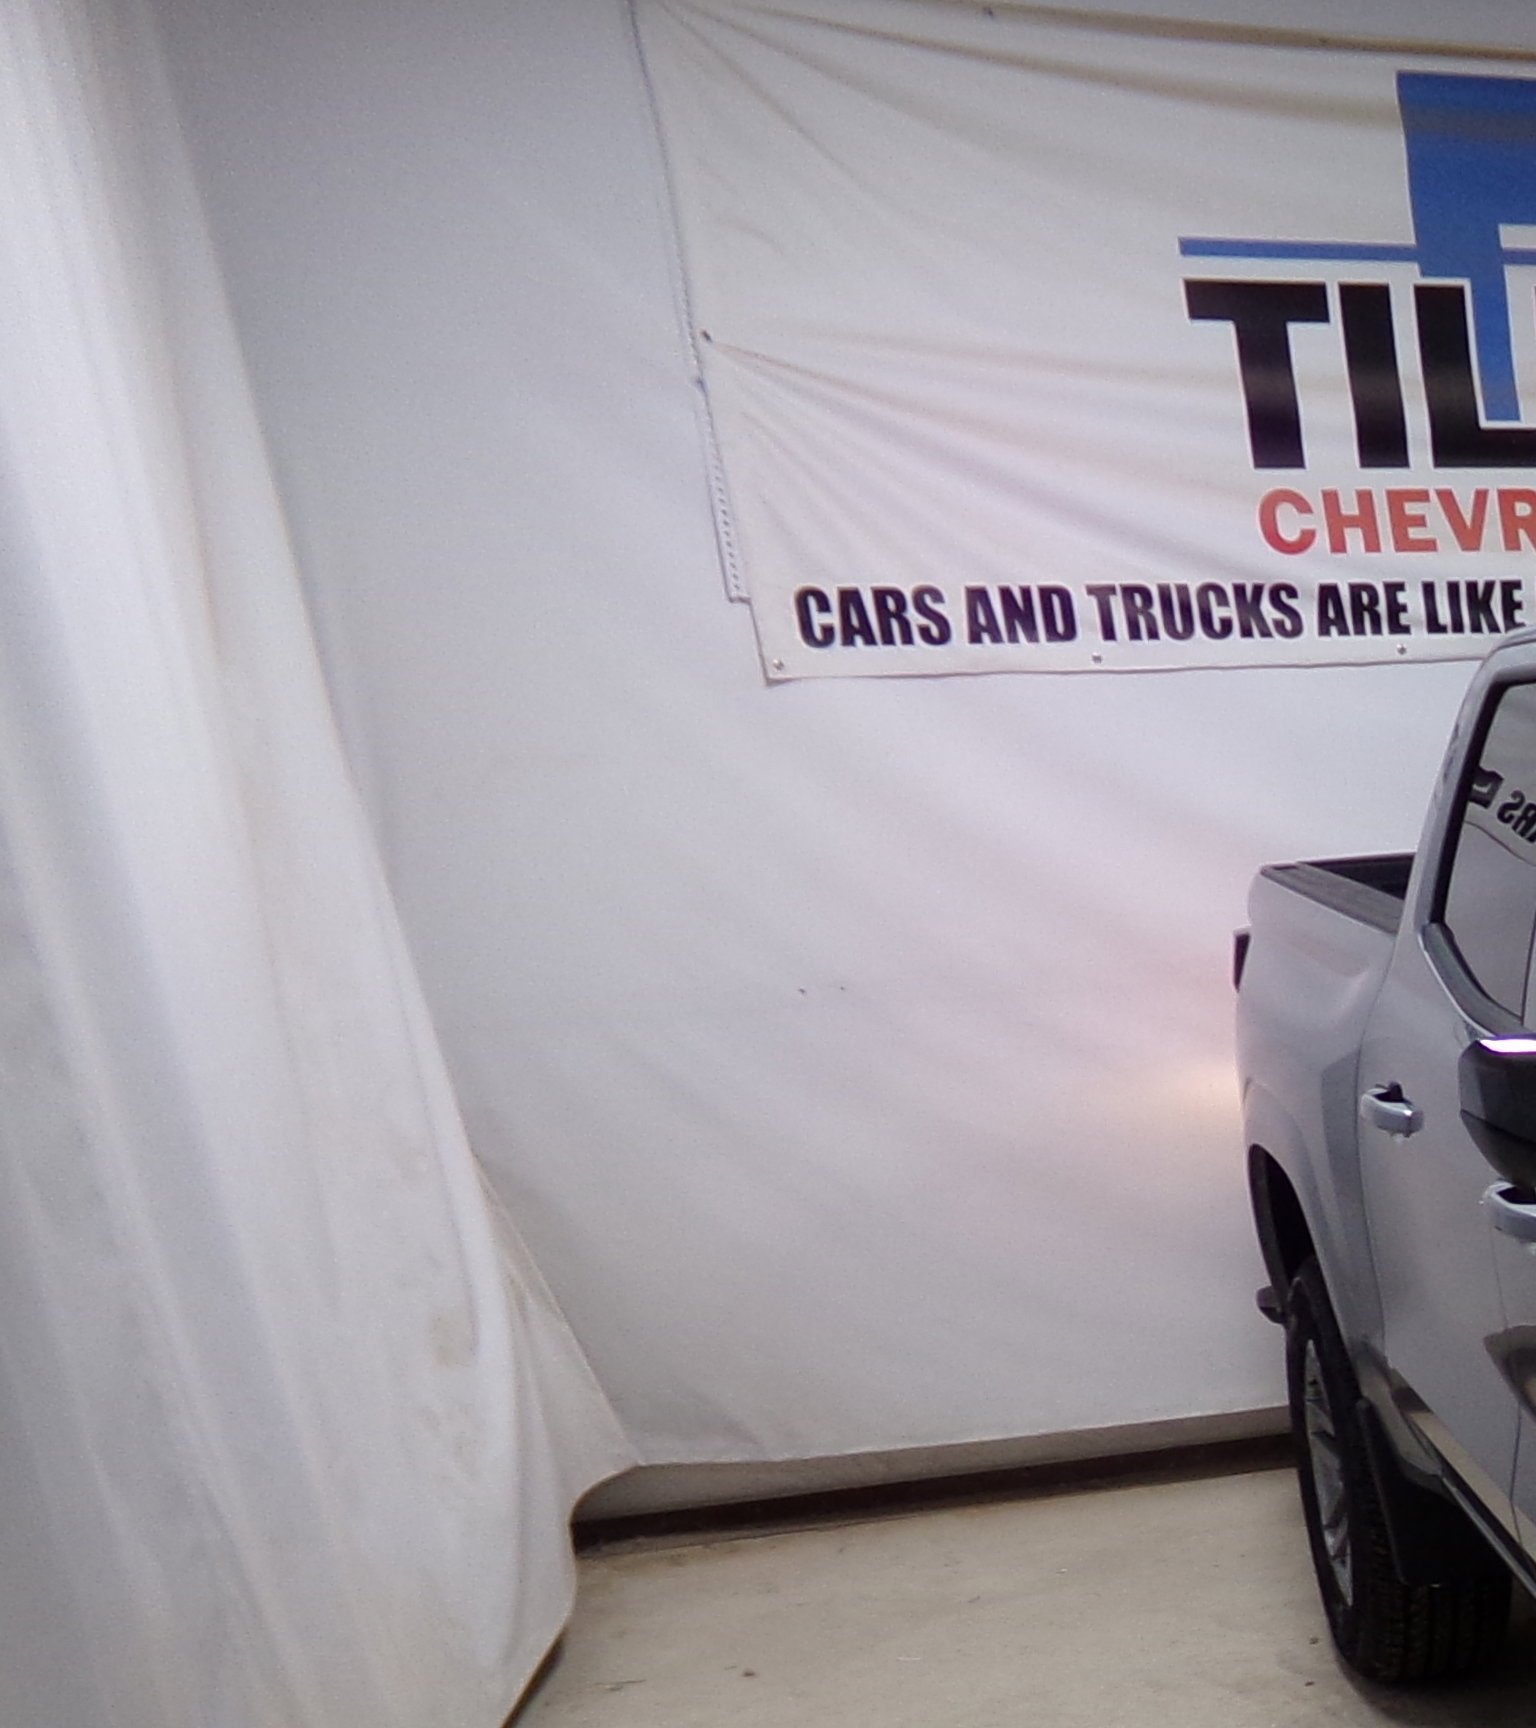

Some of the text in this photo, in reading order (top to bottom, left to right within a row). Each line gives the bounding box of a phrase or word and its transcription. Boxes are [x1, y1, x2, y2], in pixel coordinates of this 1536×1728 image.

[798, 585, 952, 648] CARS
[966, 584, 1078, 644] AND
[1084, 582, 1304, 642] TRUCKS
[1316, 581, 1409, 638] ARE
[1424, 579, 1525, 635] LIKE
